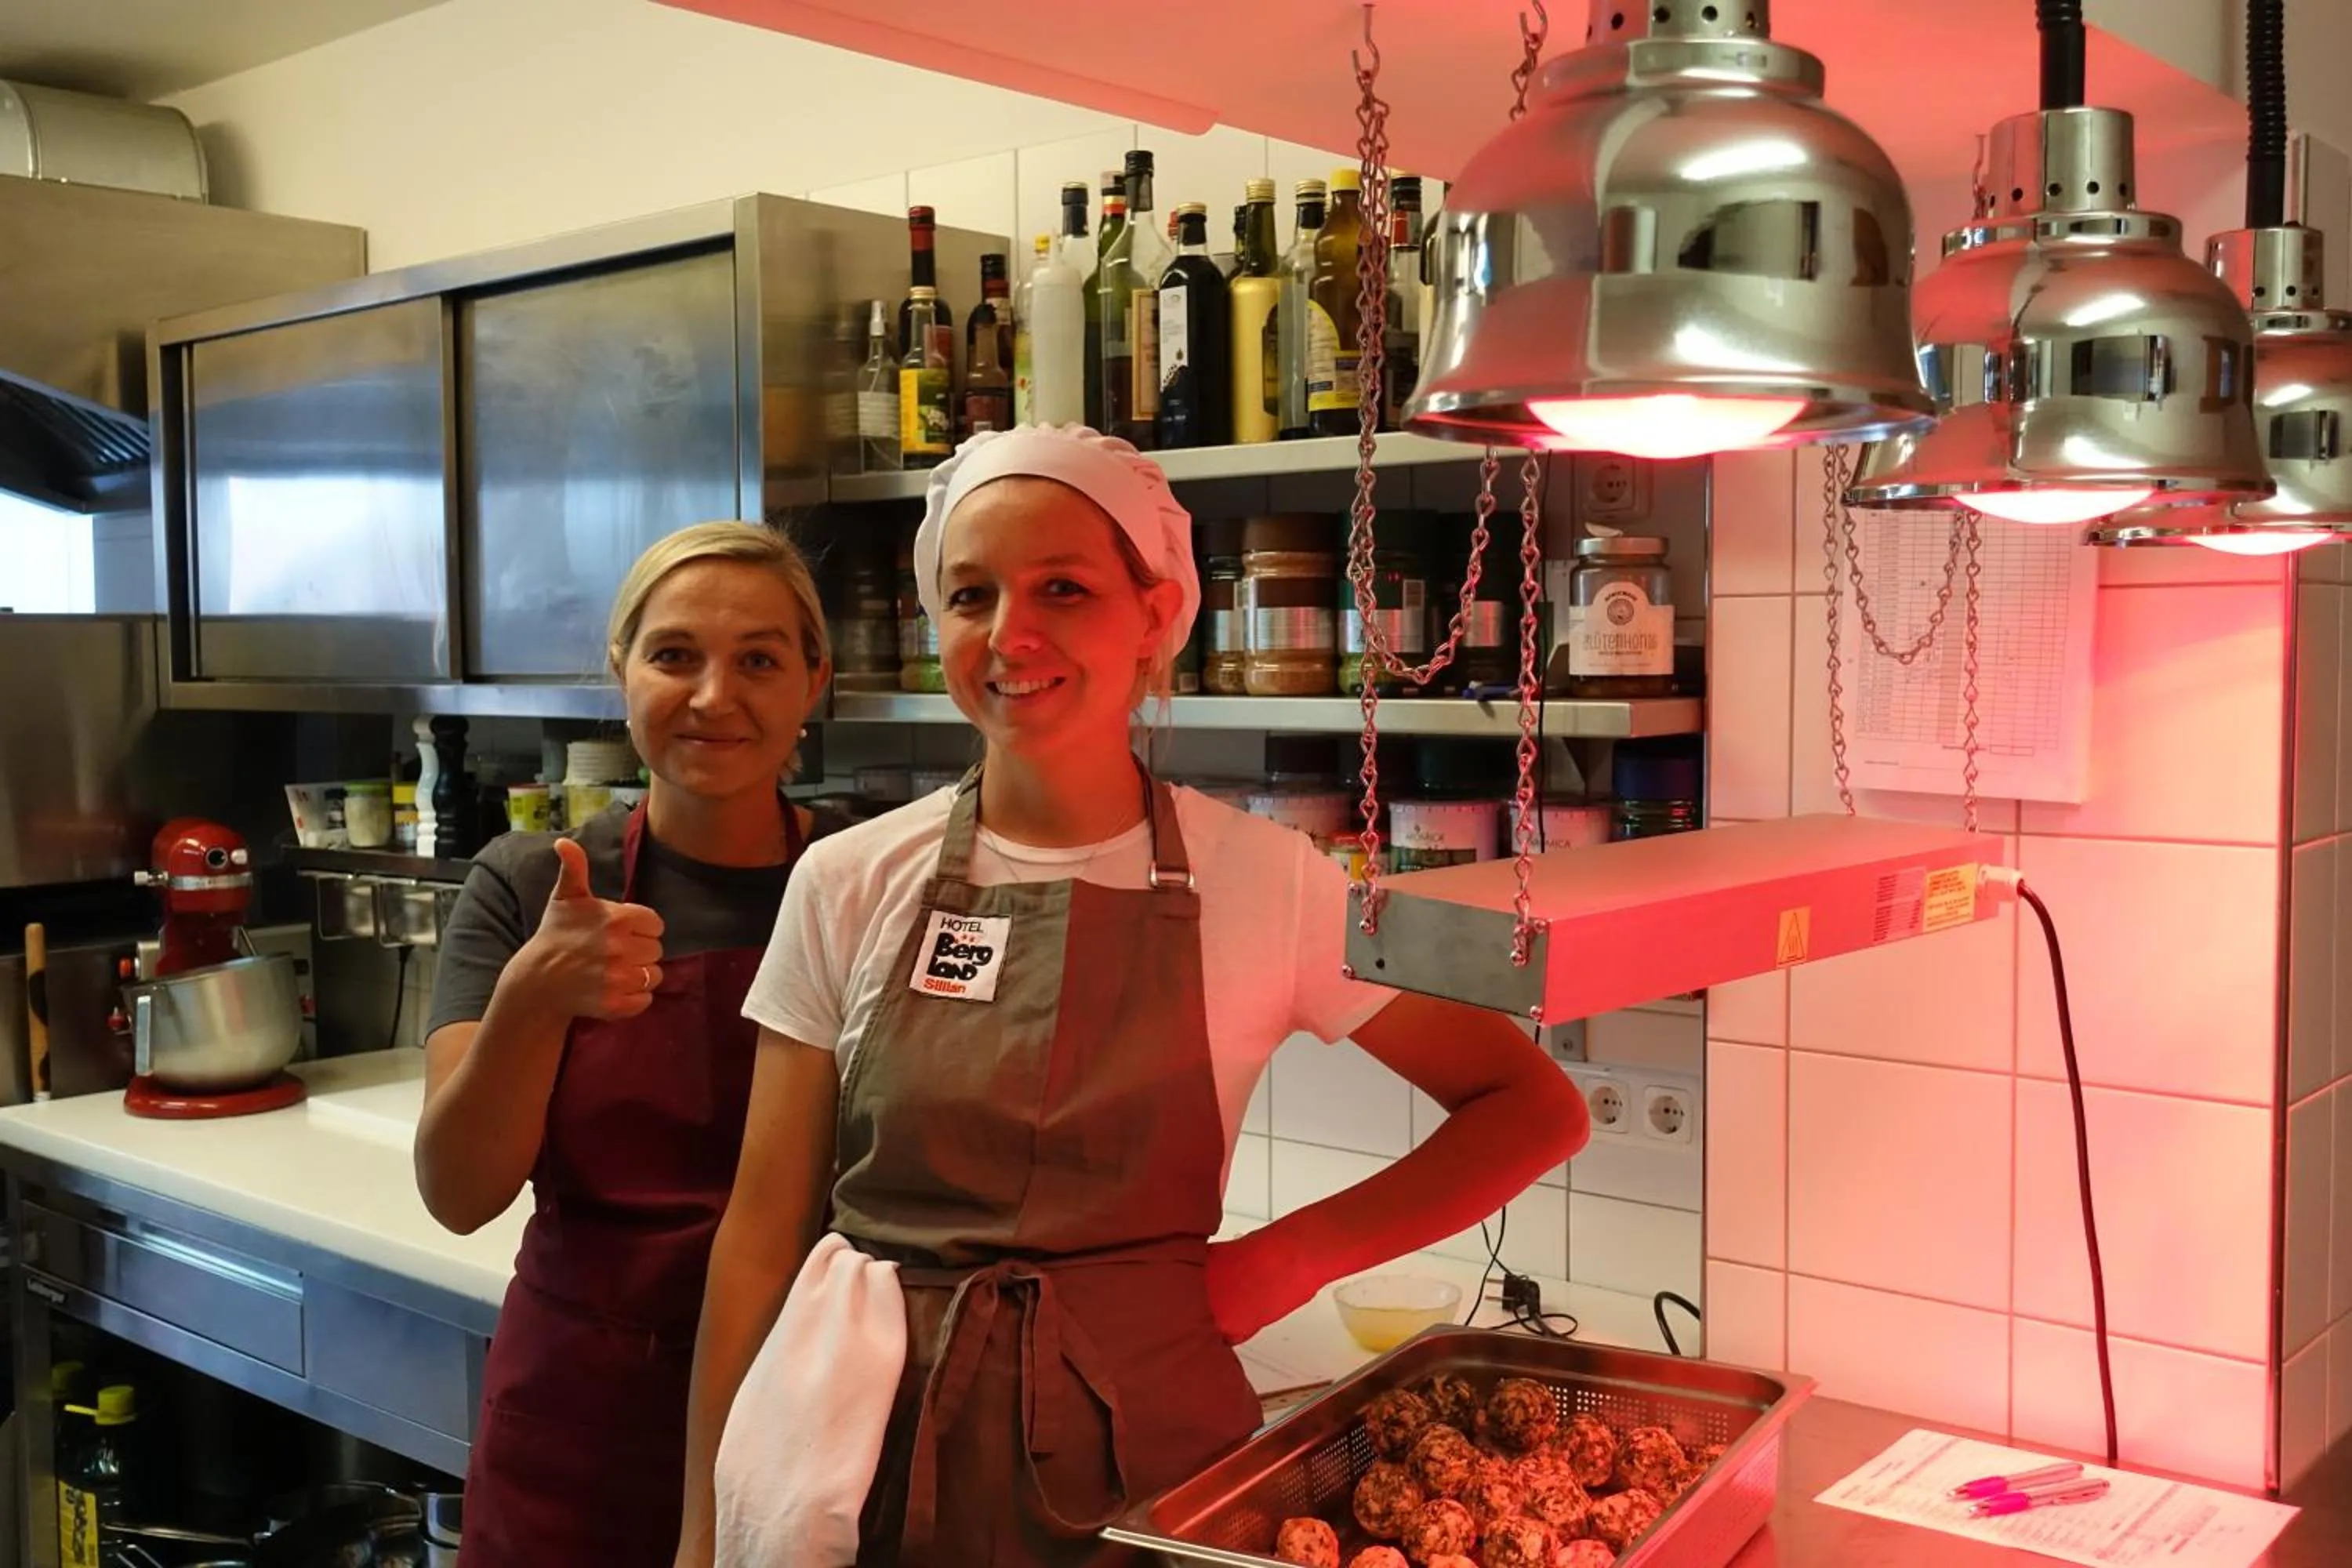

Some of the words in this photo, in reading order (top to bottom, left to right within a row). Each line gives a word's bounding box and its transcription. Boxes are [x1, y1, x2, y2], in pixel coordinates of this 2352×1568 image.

[1527, 838, 1571, 848] ARMICA
[941, 916, 983, 933] HOTEL
[934, 932, 993, 966] Berg
